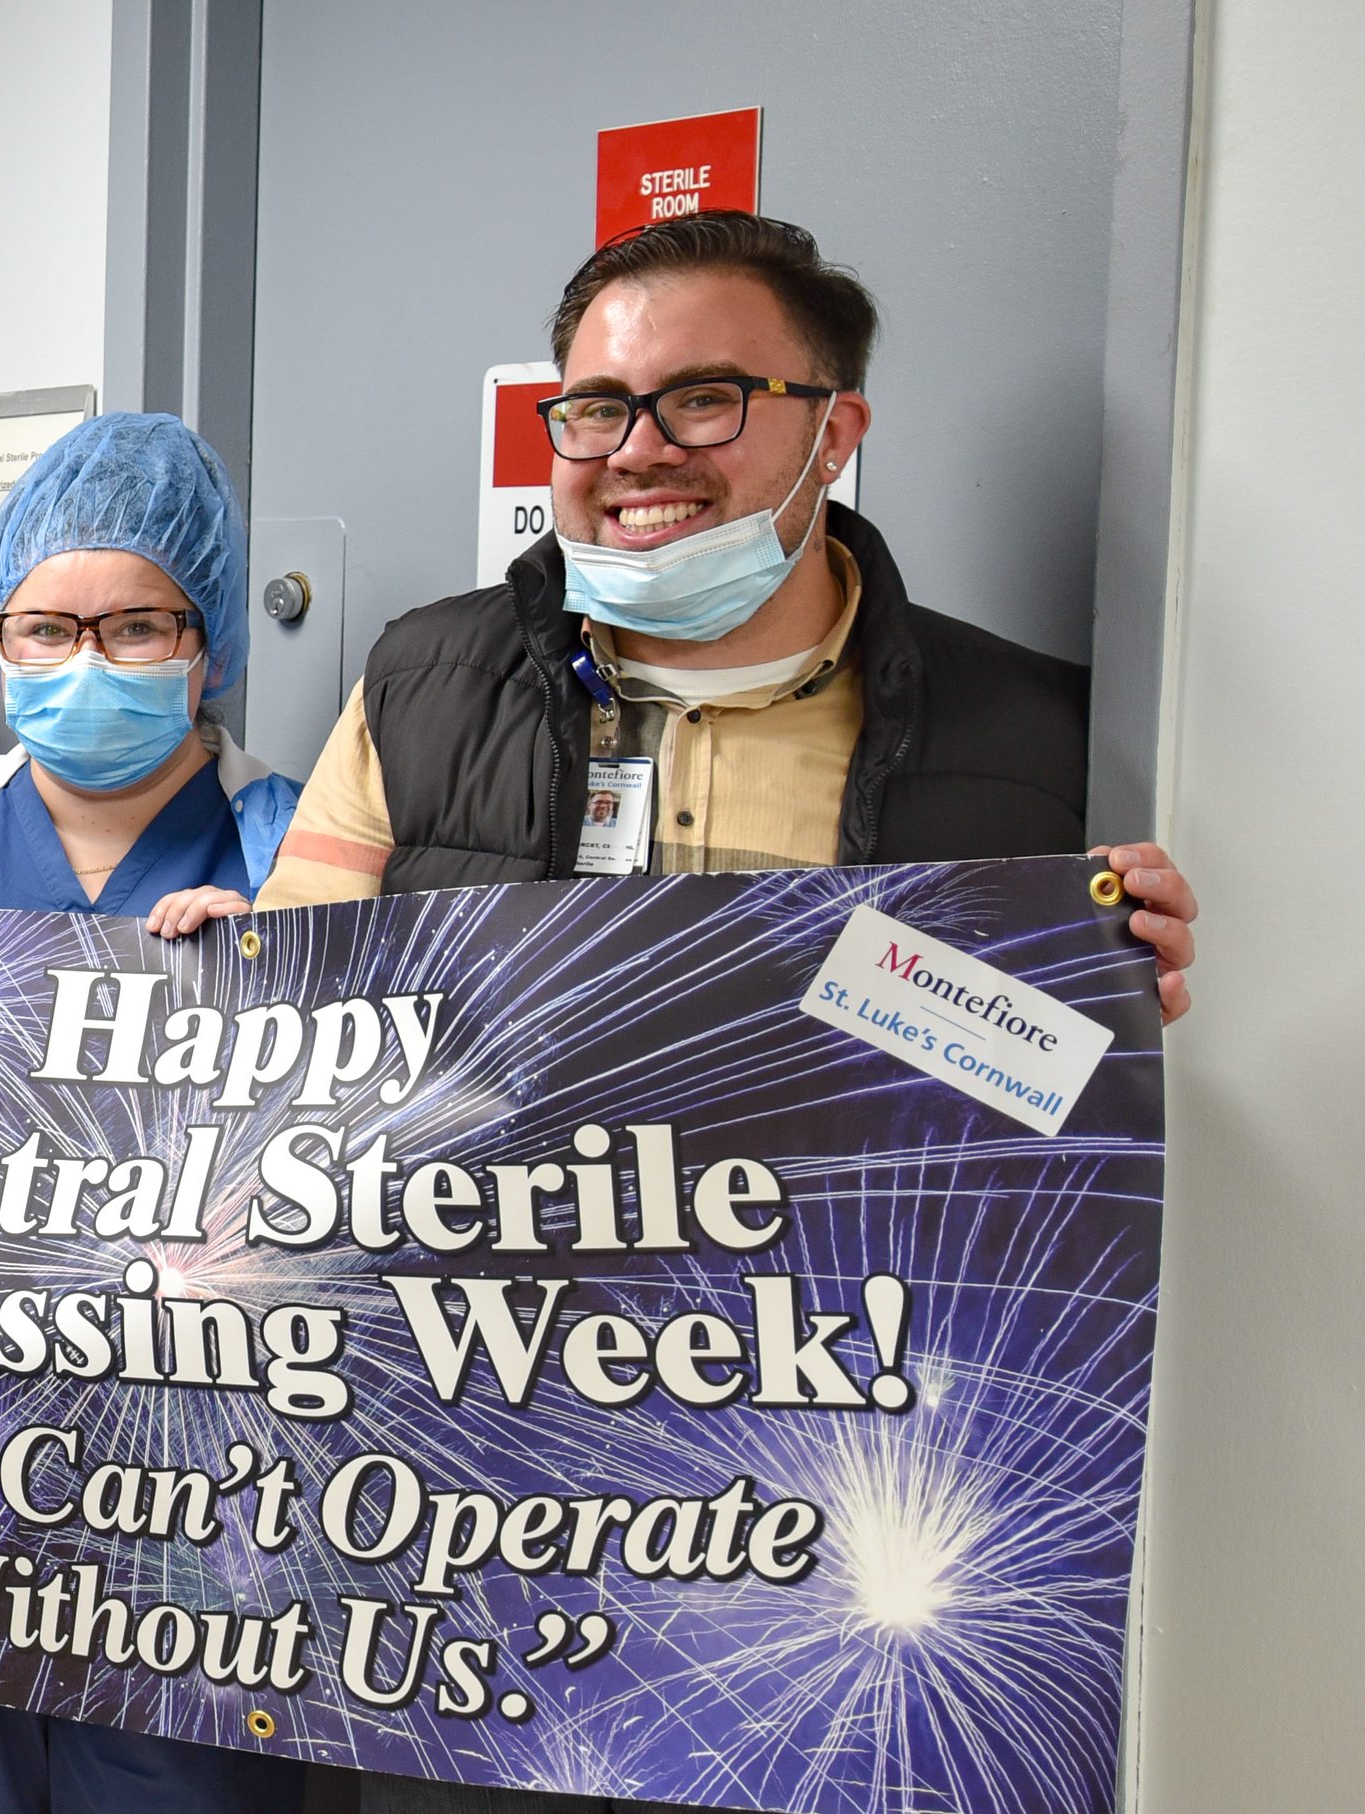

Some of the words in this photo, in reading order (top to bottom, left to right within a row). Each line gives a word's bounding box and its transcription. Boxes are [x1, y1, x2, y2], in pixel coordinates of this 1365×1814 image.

[640, 165, 711, 196] STERILE
[652, 192, 699, 219] ROOM
[6, 452, 29, 462] Sterile
[514, 505, 545, 534] DO
[30, 966, 445, 1106] Happy
[819, 980, 850, 1010] St.
[857, 999, 938, 1051] Luke’s
[943, 1042, 1064, 1116] Cornwall
[875, 941, 1059, 1052] Montefiore
[249, 1121, 787, 1252] Sterile
[381, 1272, 911, 1411] Week!
[320, 1453, 819, 1595] Operate
[339, 1596, 612, 1720] Us.”
